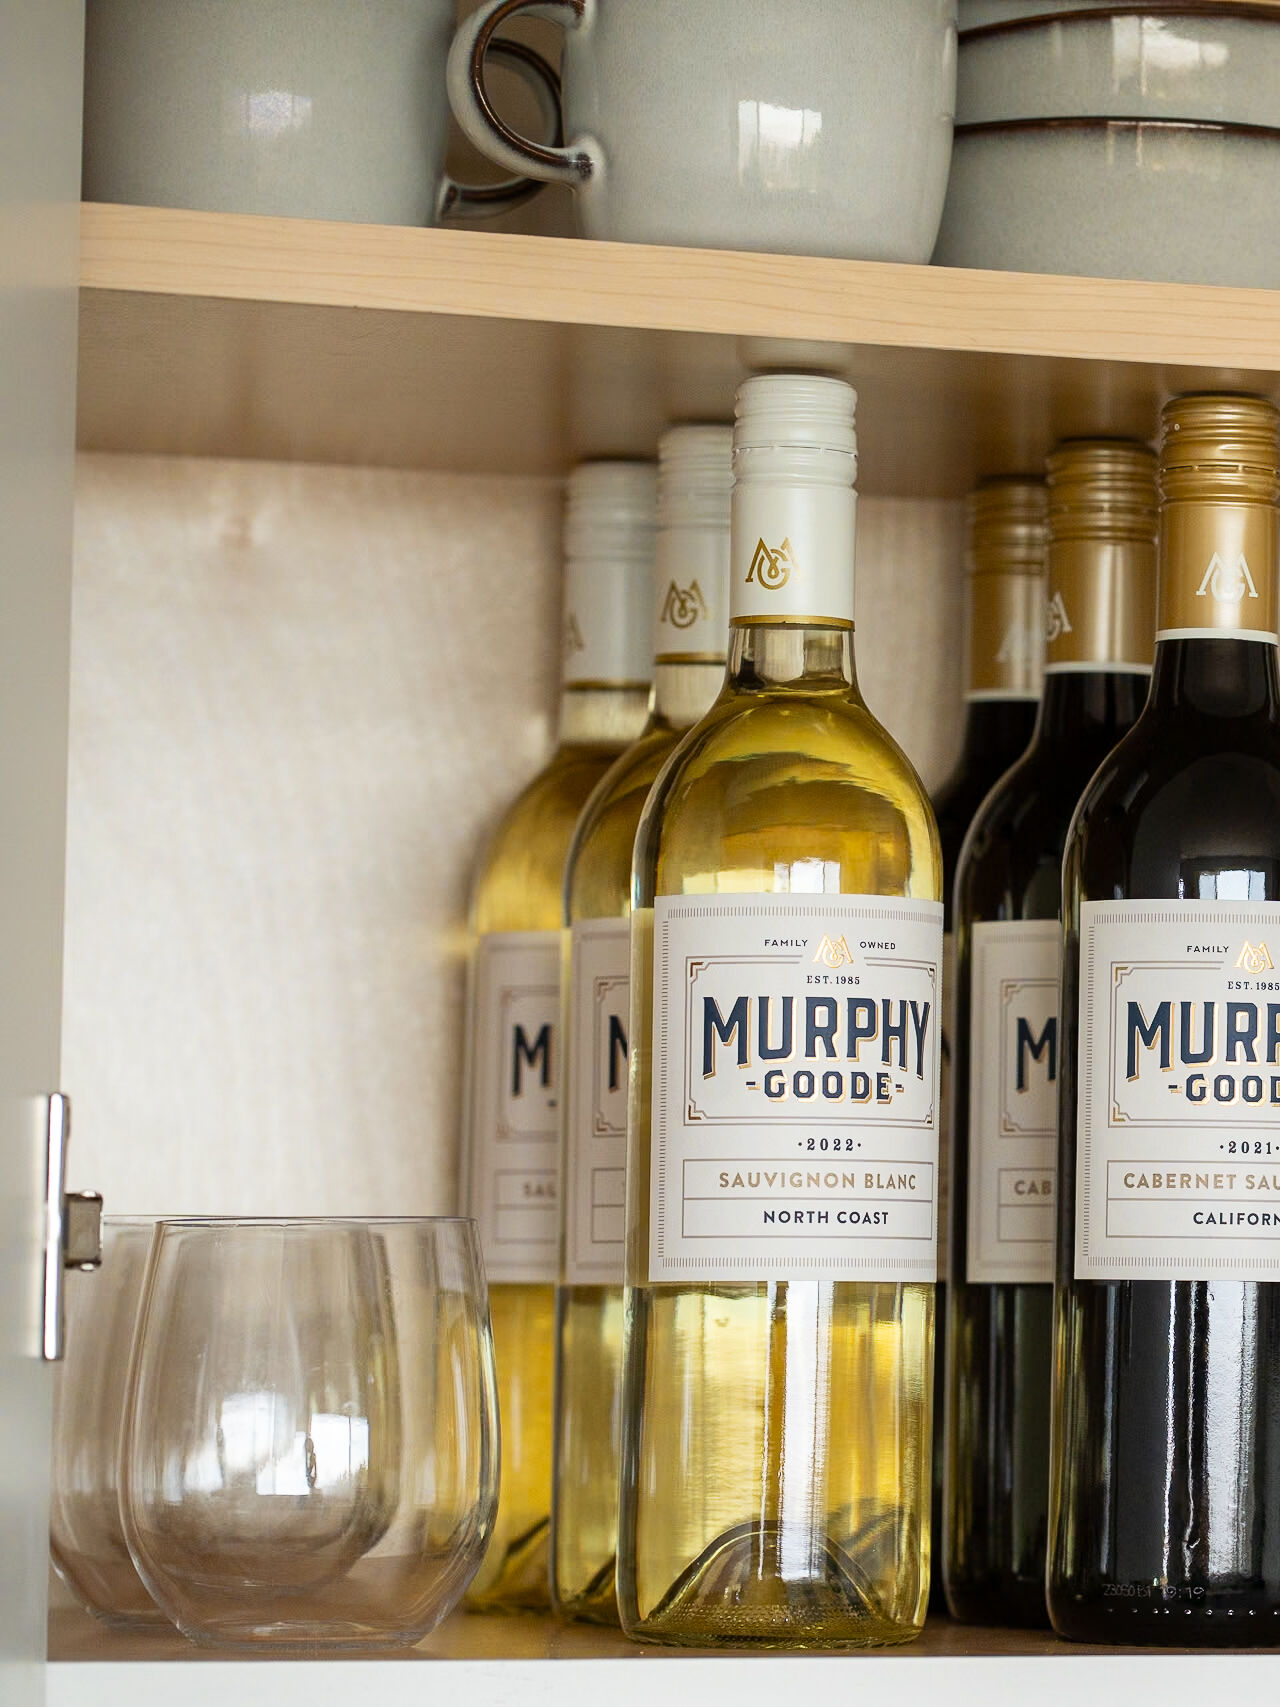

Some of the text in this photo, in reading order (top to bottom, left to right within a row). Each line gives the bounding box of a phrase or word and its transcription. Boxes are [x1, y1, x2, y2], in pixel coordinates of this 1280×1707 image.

[764, 939, 896, 950] FAMILY OWNED
[1187, 945, 1229, 954] FAMILY
[702, 996, 930, 1080] MURPHY
[719, 1172, 916, 1190] SAUVIGNON BLANC
[1124, 1172, 1236, 1190] CABERNET
[763, 1211, 888, 1224] NORTH COAST
